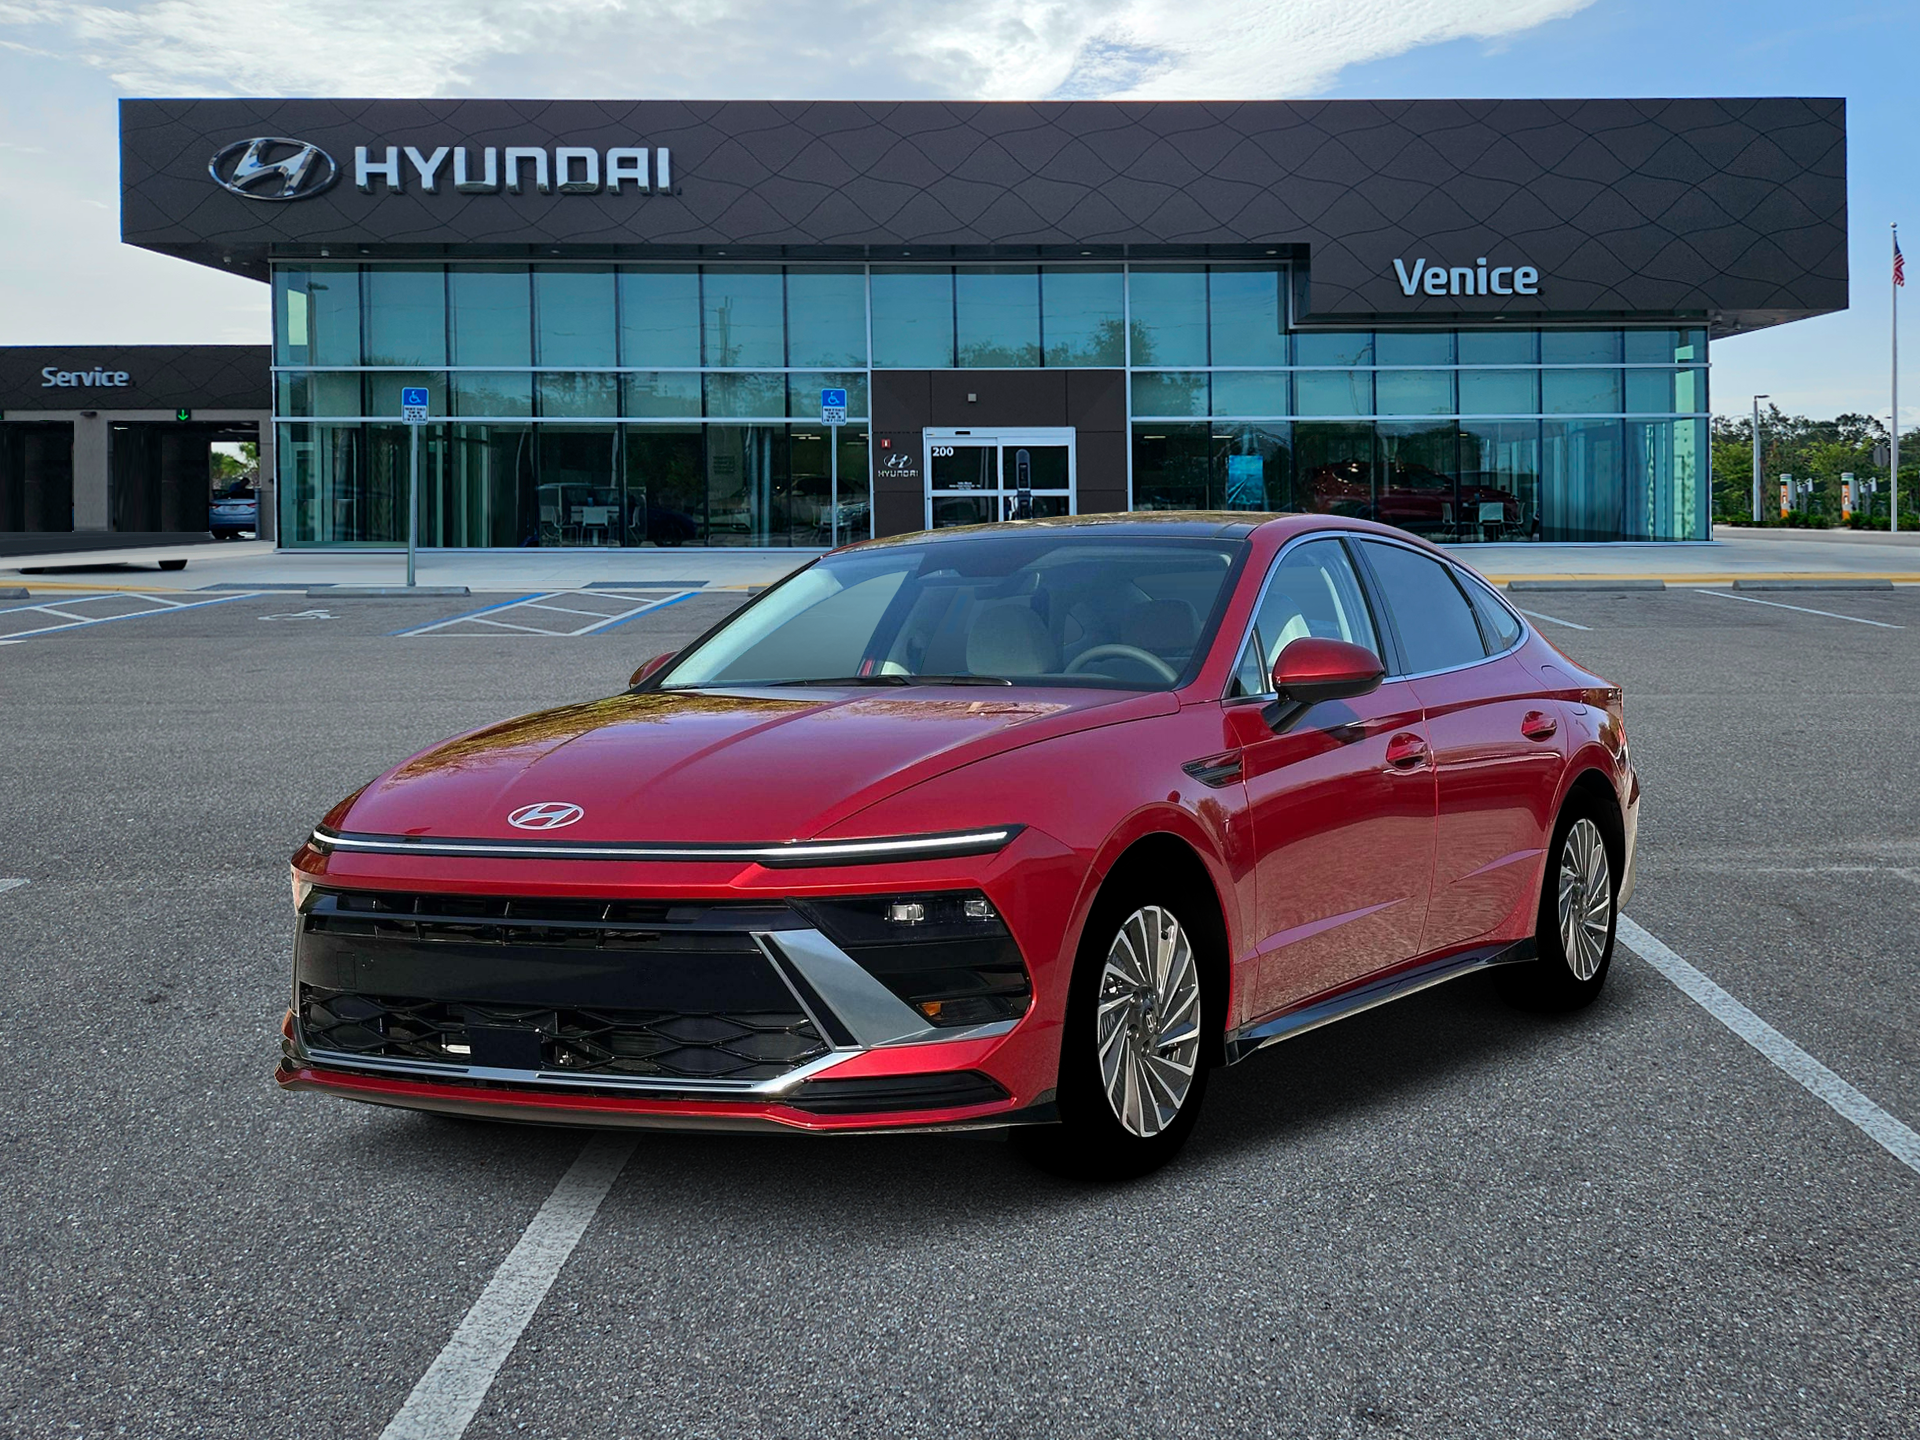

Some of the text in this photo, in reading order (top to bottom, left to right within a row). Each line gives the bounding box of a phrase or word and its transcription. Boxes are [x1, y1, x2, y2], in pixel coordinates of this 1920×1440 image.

[354, 146, 673, 195] HYUNDAI
[1392, 257, 1539, 296] Venice
[41, 366, 130, 388] Service
[932, 446, 955, 457] 200
[878, 470, 918, 478] HYUNDAI
